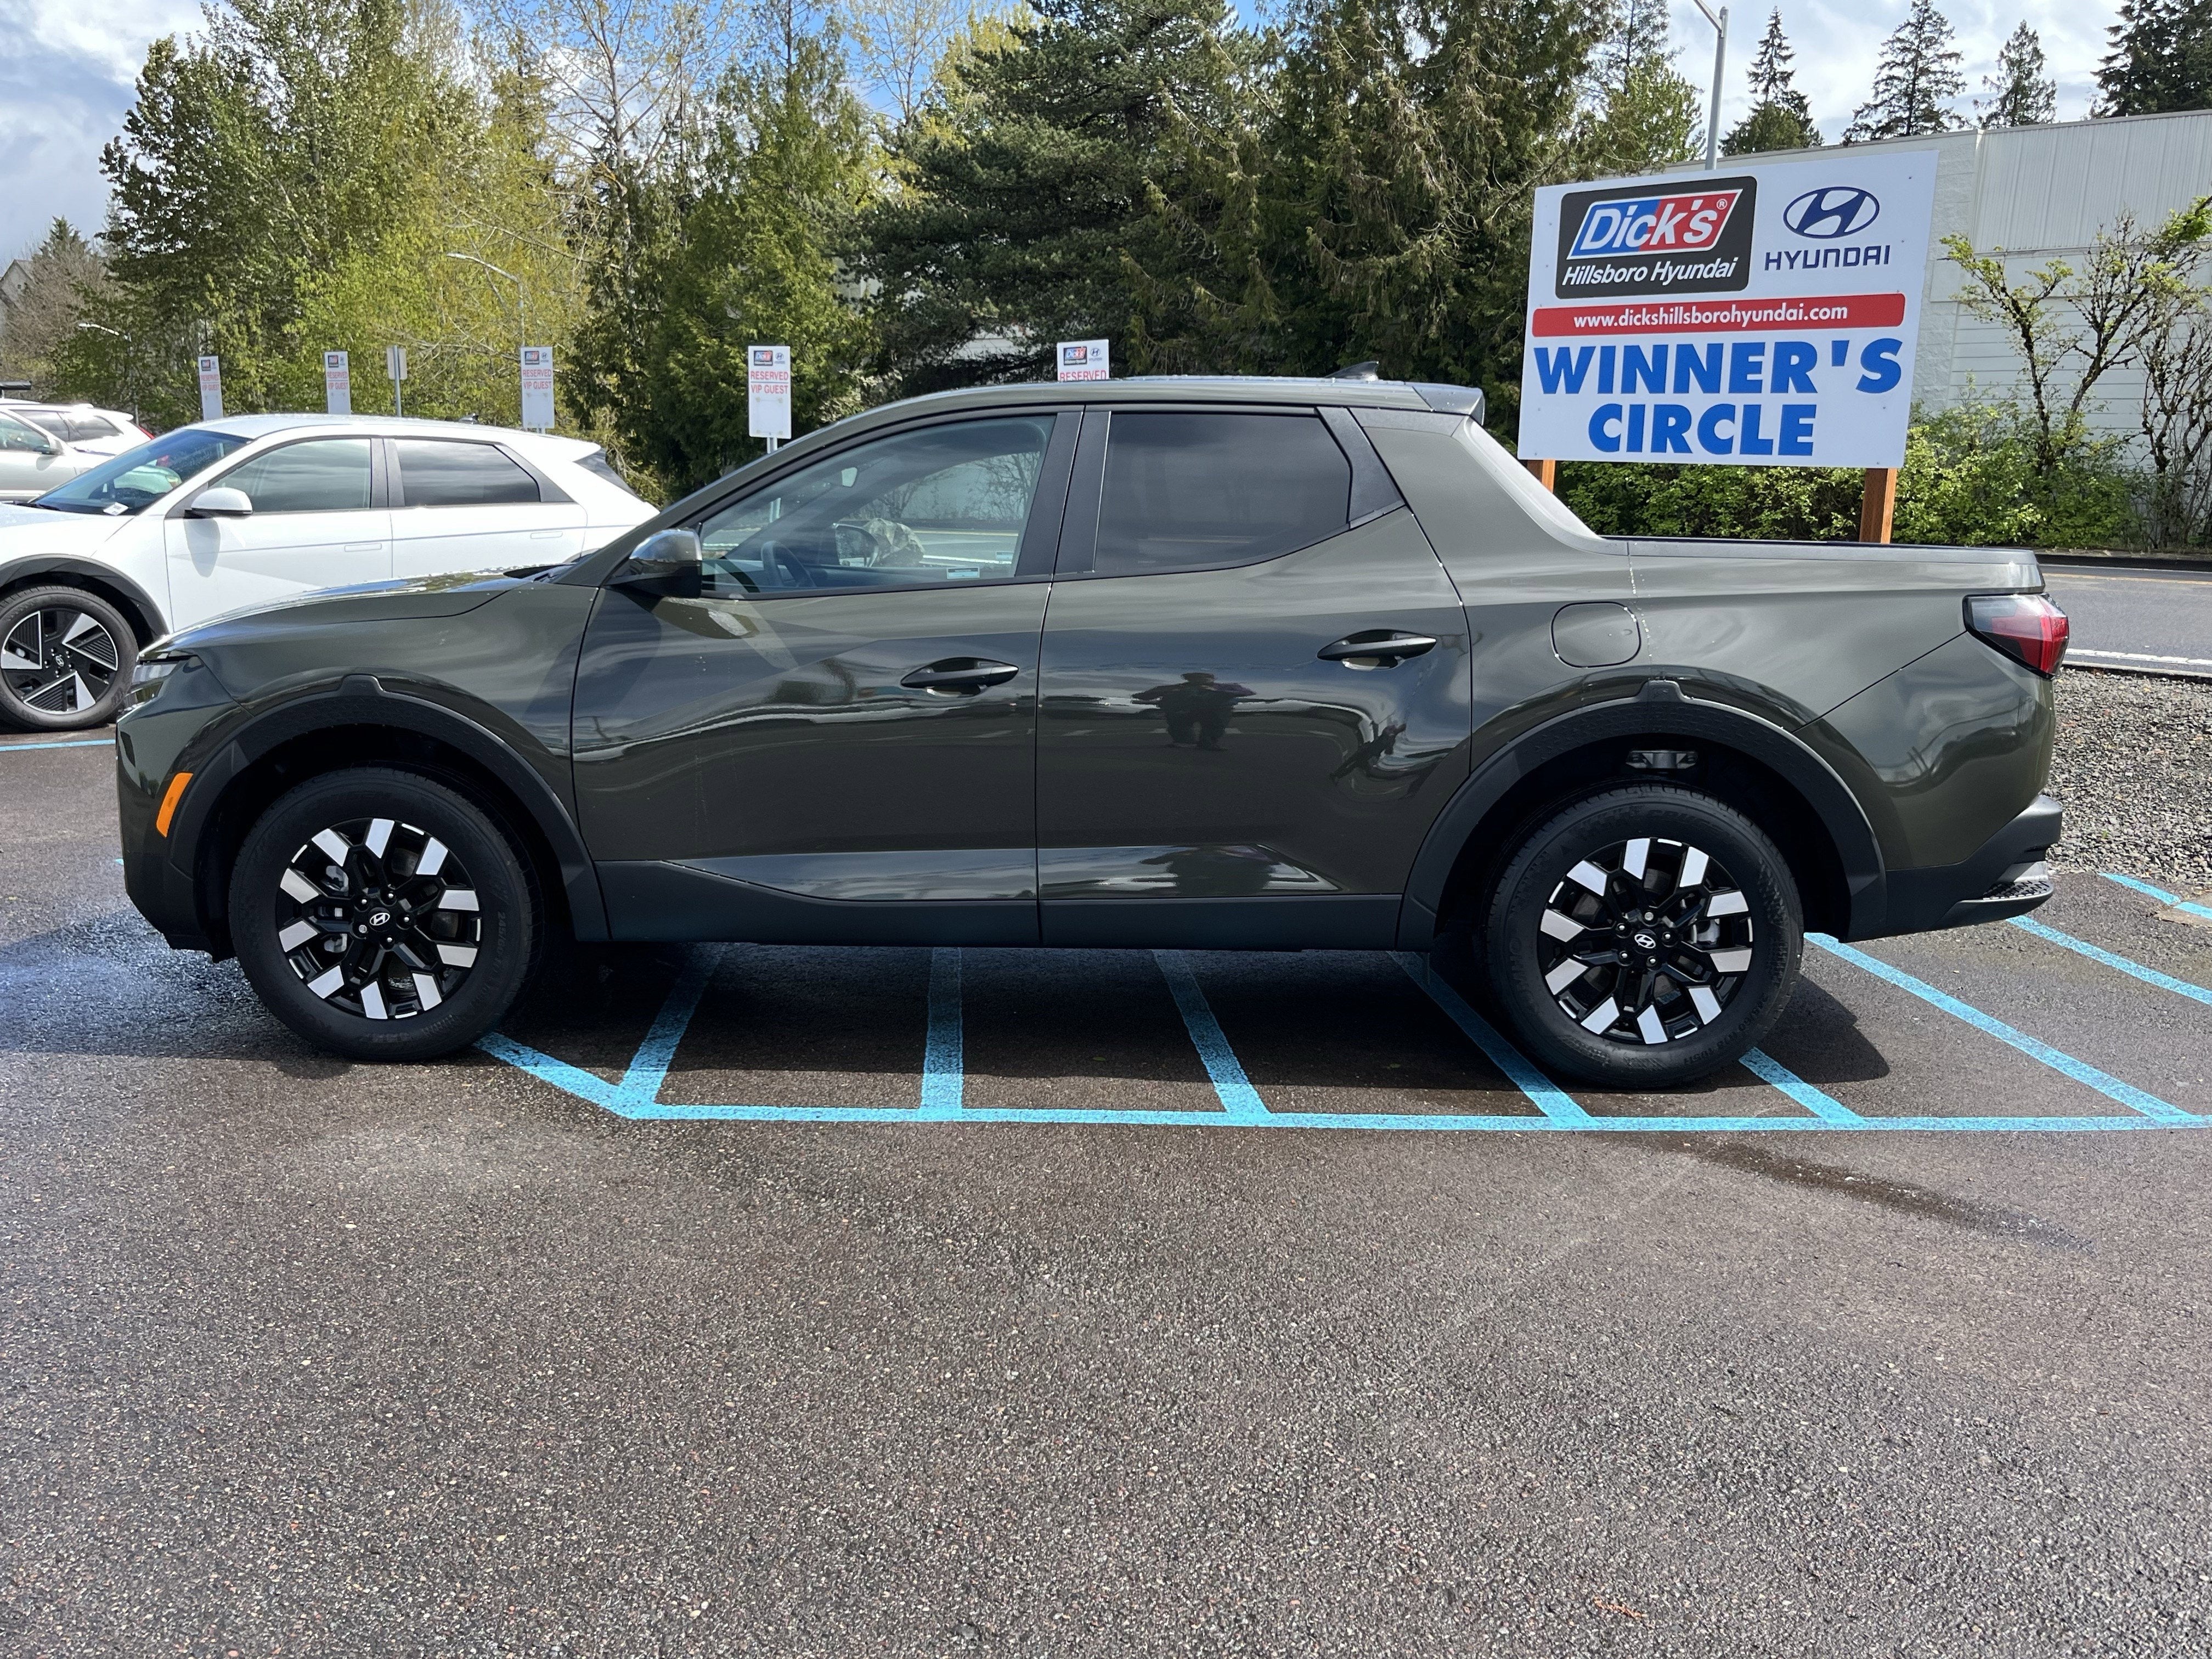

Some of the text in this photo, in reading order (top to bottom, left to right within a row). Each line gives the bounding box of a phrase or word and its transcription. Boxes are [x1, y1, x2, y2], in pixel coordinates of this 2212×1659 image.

[1764, 245, 1891, 271] HYUNDAI
[1562, 257, 1739, 286] Hillsboro Hyundai
[1573, 304, 1848, 329] www.dickshillsborohyundai.com
[523, 369, 551, 377] RESERVED
[1534, 338, 1903, 394] WINNER'S
[751, 371, 788, 380] RESERVED
[1060, 370, 1106, 381] RESERVED
[533, 381, 551, 390] GUEST
[751, 385, 788, 394] VIP GUEST
[1588, 403, 1817, 456] CIRCLE
